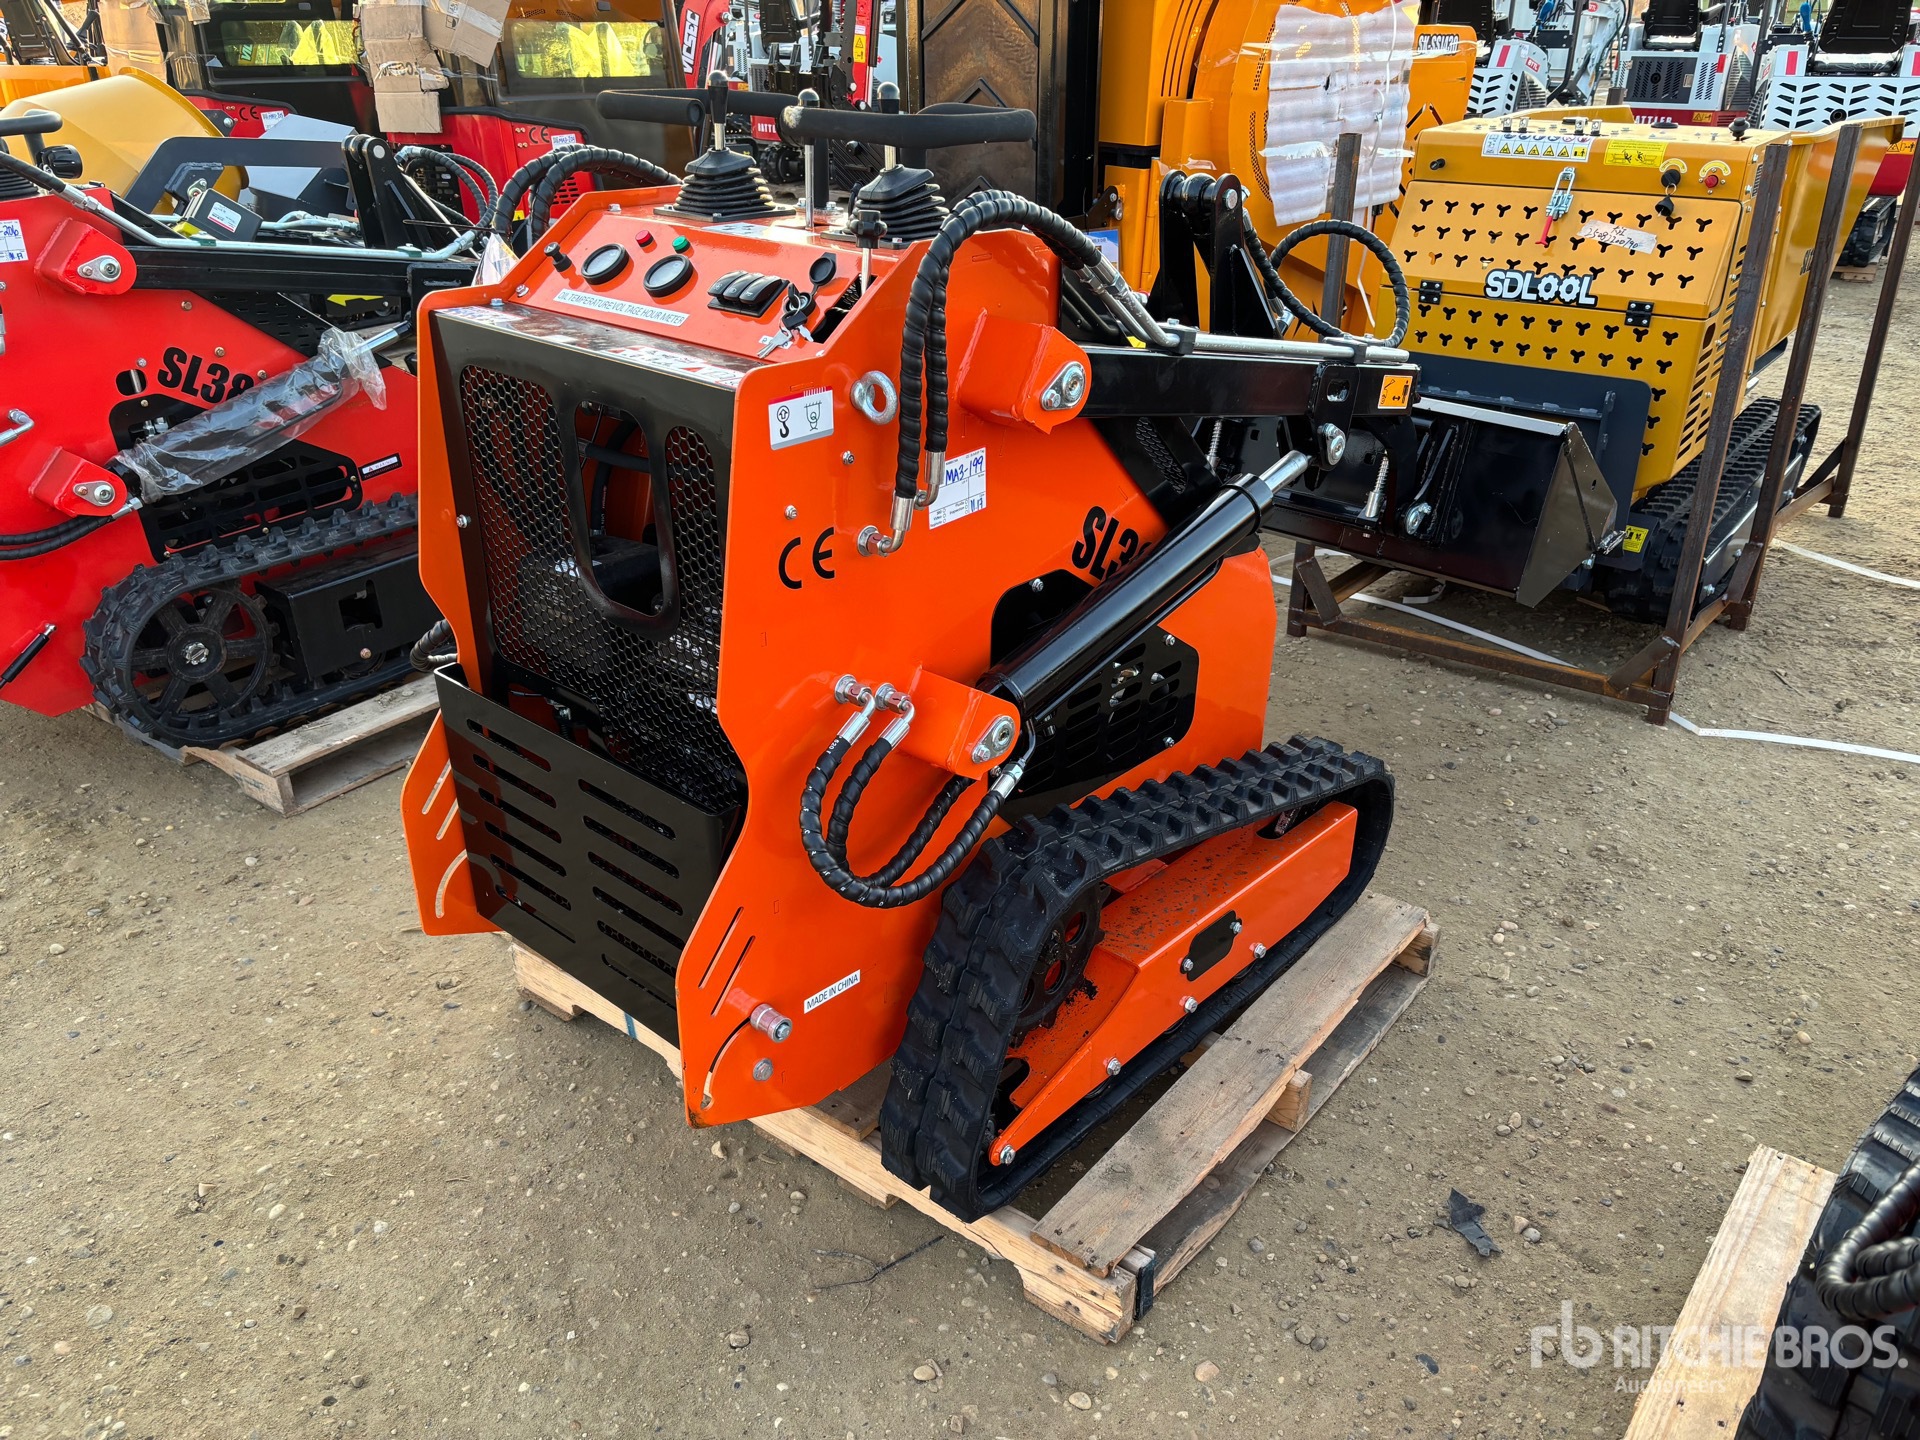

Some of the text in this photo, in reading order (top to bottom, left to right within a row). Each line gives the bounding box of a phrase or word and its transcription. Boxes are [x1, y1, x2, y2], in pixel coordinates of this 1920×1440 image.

[682, 8, 701, 74] VICSEC
[239, 105, 260, 121] CE
[1634, 115, 1673, 125] ATTLER
[529, 126, 550, 144] CE
[1485, 270, 1597, 305] SDLOOL
[641, 309, 664, 320] HOUR
[661, 312, 686, 324] METER
[945, 455, 984, 486] MA3-199
[778, 526, 835, 590] CE
[1072, 506, 1152, 580] SL3
[807, 974, 859, 1010] MADE IN CHINA
